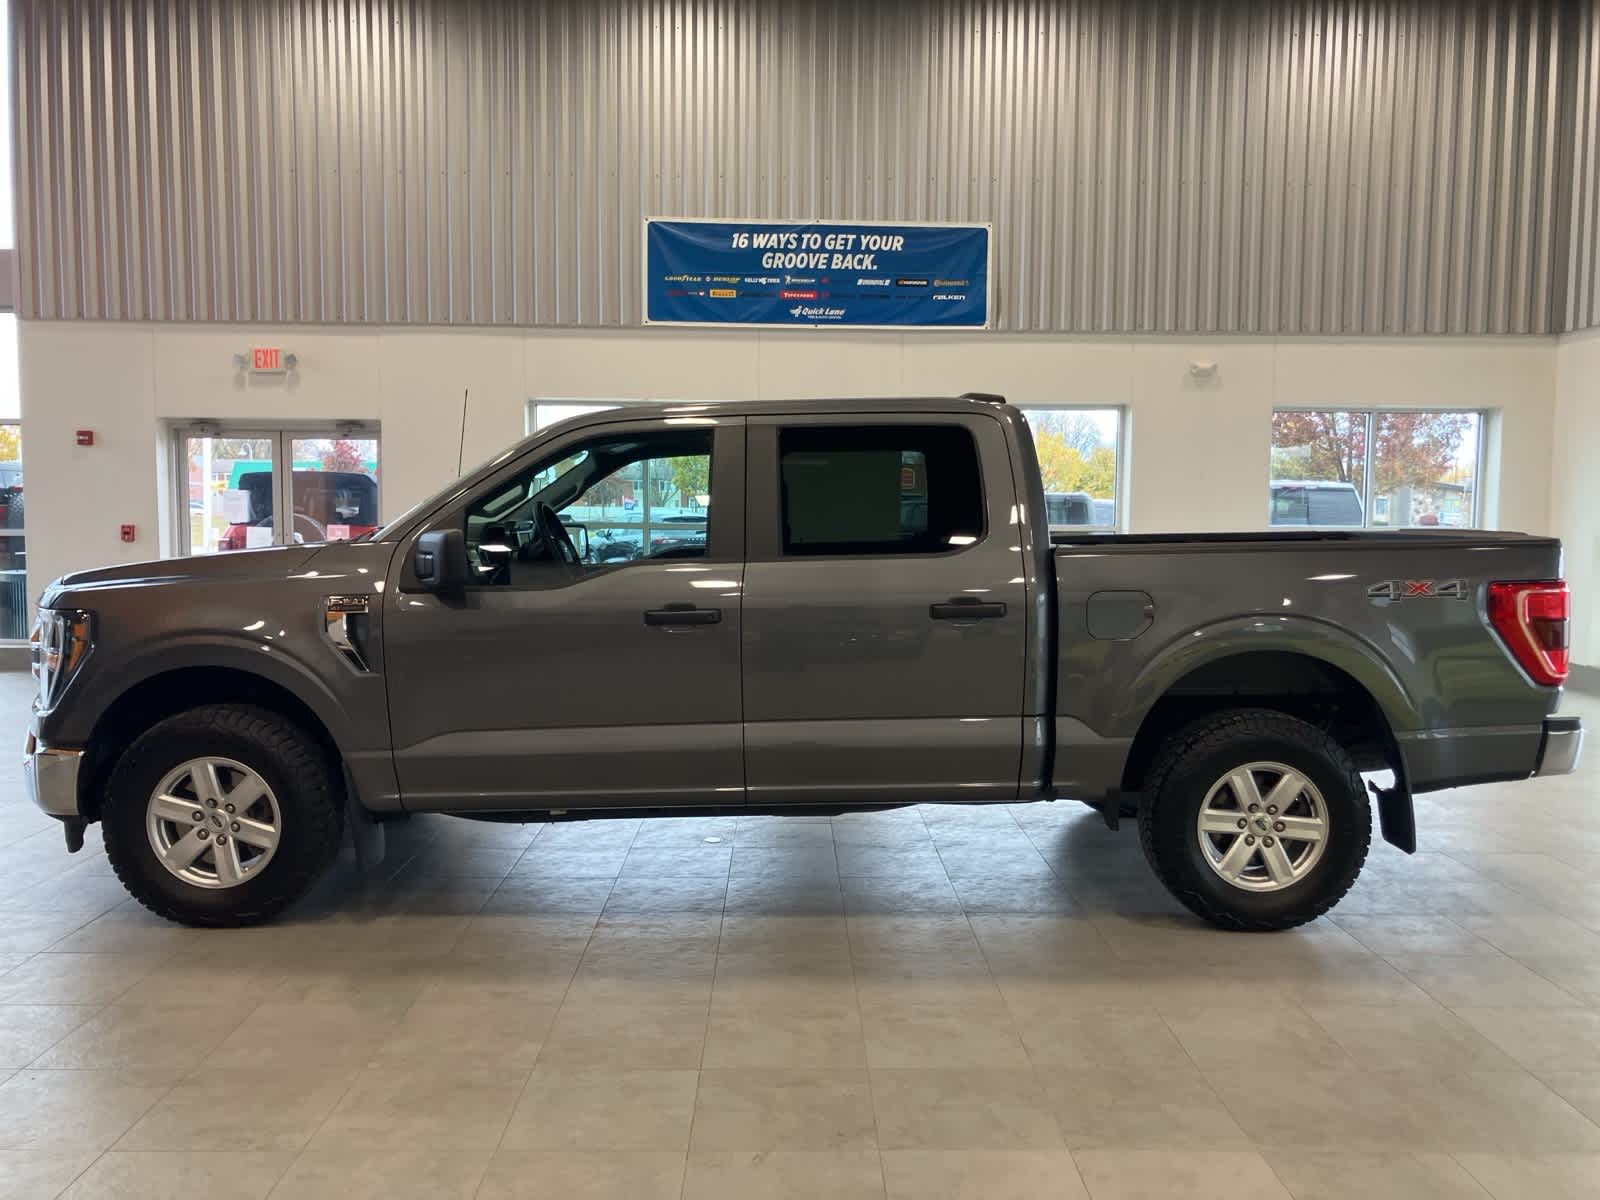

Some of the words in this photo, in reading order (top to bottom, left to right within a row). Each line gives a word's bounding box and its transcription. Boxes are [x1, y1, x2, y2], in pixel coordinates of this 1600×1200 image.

[732, 232, 749, 249] 16
[752, 233, 798, 250] WAYS
[801, 233, 821, 250] TO
[824, 234, 856, 250] GET
[860, 235, 904, 251] YOUR
[762, 252, 829, 269] GROOVE
[831, 254, 878, 270] BACK.
[801, 306, 825, 316] Quick
[824, 307, 846, 316] Lane
[254, 348, 281, 369] EXIT
